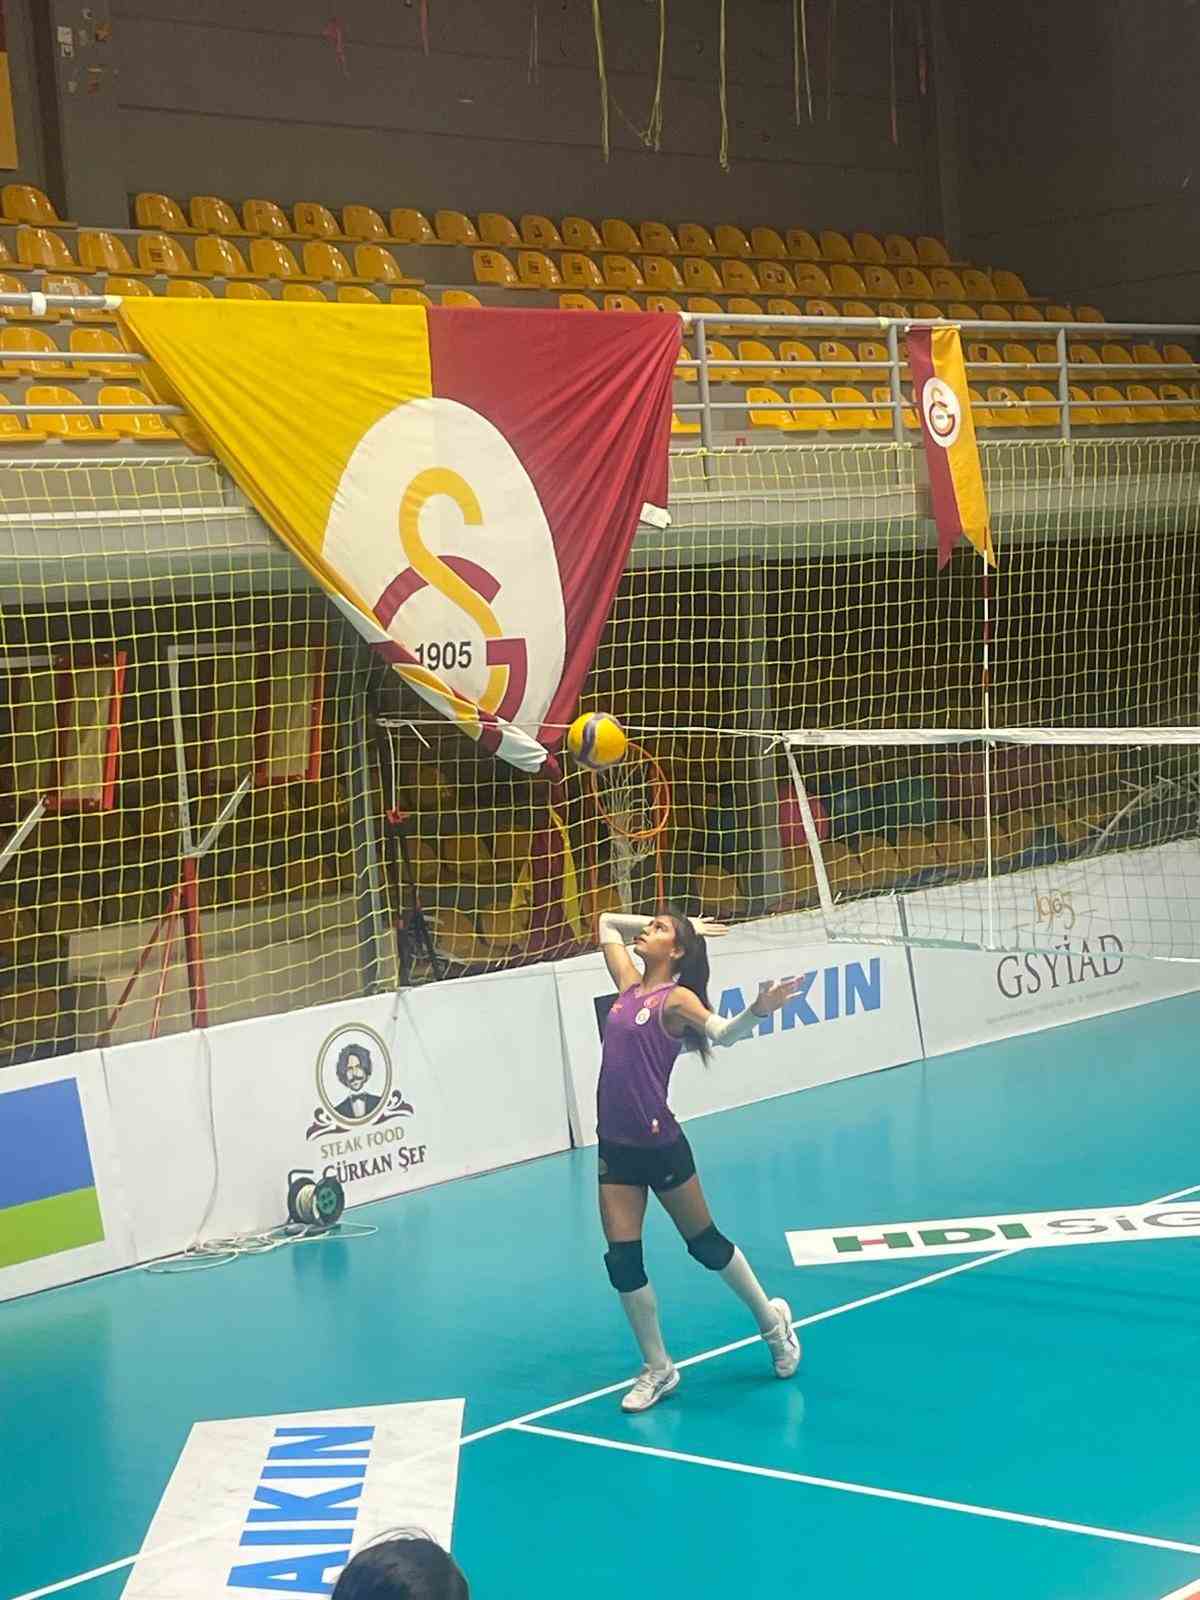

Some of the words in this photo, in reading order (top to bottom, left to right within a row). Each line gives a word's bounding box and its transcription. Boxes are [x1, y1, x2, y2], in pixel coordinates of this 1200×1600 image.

[415, 641, 472, 671] 1905
[997, 934, 1124, 999] GSYİAD
[320, 1135, 362, 1160] STEAK
[366, 1126, 405, 1147] FOOD
[397, 1145, 427, 1173] ŞEF
[832, 1223, 1033, 1253] HDI
